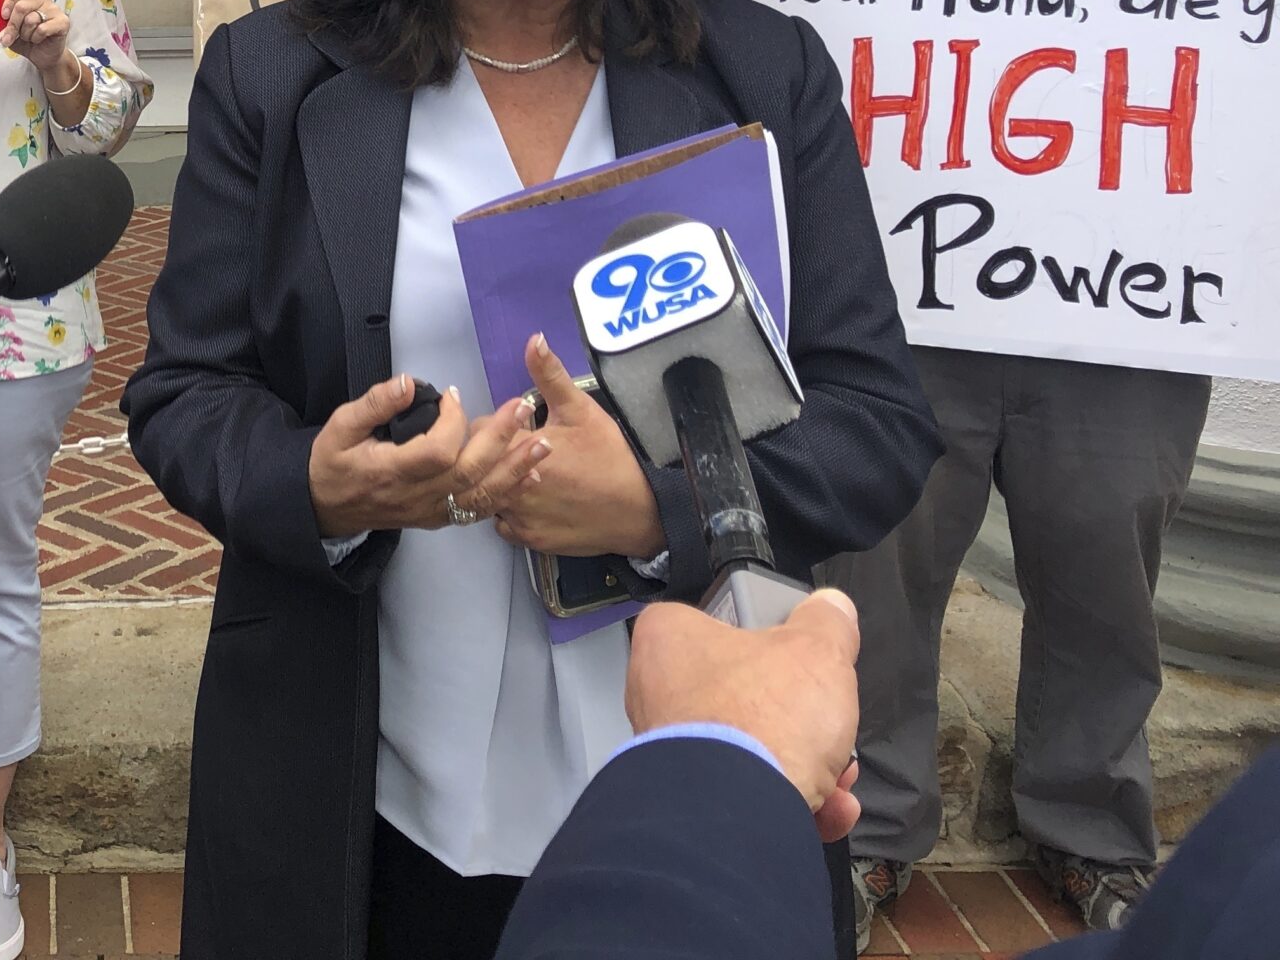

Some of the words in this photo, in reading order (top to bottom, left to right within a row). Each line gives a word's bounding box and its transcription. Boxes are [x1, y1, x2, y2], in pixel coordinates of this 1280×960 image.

[851, 36, 1200, 194] HIGH
[603, 283, 718, 338] WUSA
[889, 193, 1223, 325] Power
